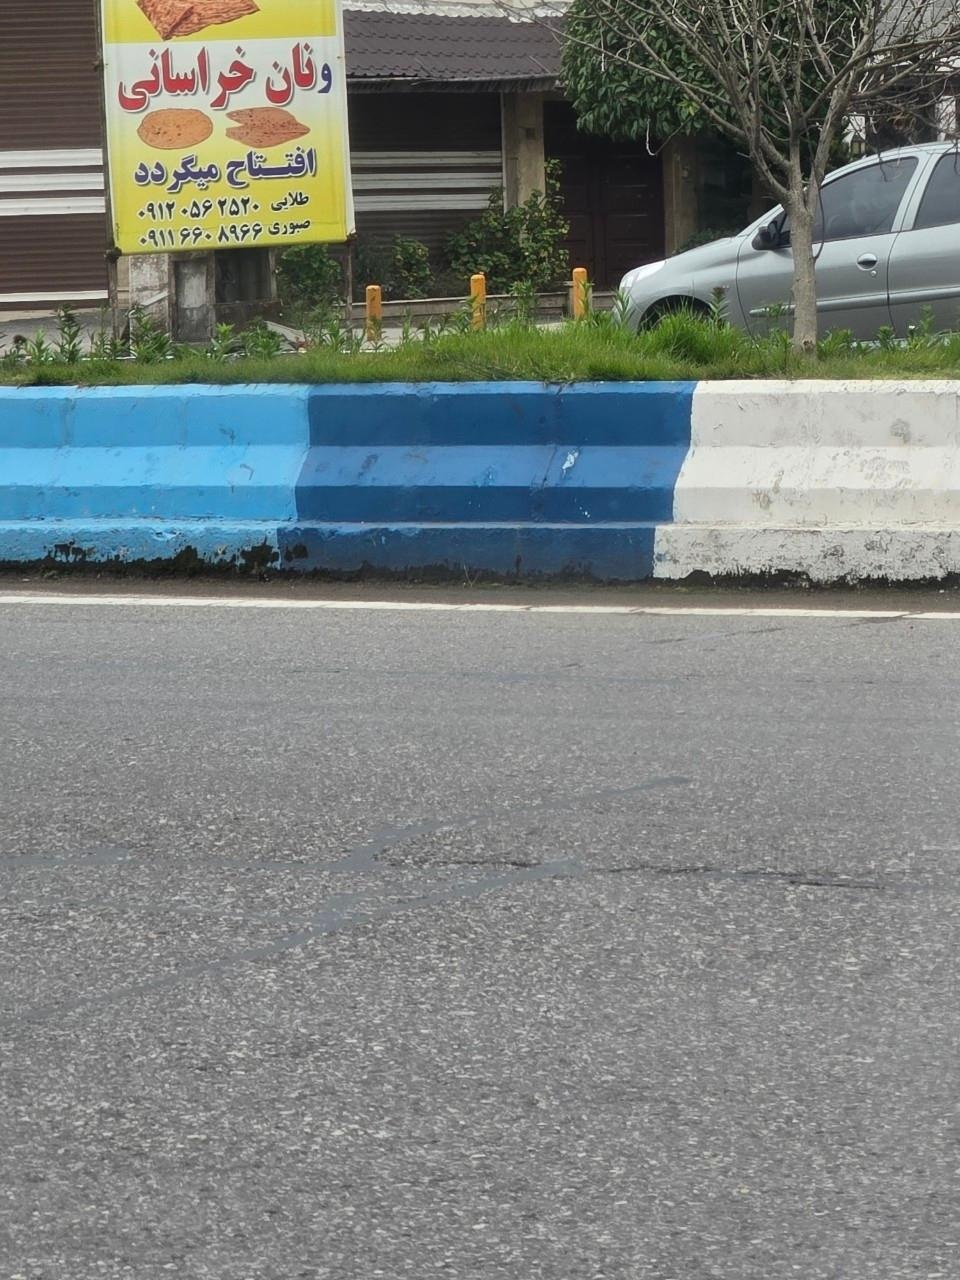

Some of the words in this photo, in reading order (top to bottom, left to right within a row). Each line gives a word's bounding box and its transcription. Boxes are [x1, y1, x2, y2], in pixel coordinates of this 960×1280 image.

[118, 45, 255, 111] خراسانی
[265, 42, 316, 105] نان
[134, 154, 220, 192] میگردد
[227, 146, 316, 187] افتتاح
[271, 191, 309, 211] طلایی
[268, 219, 311, 236] صبوری
